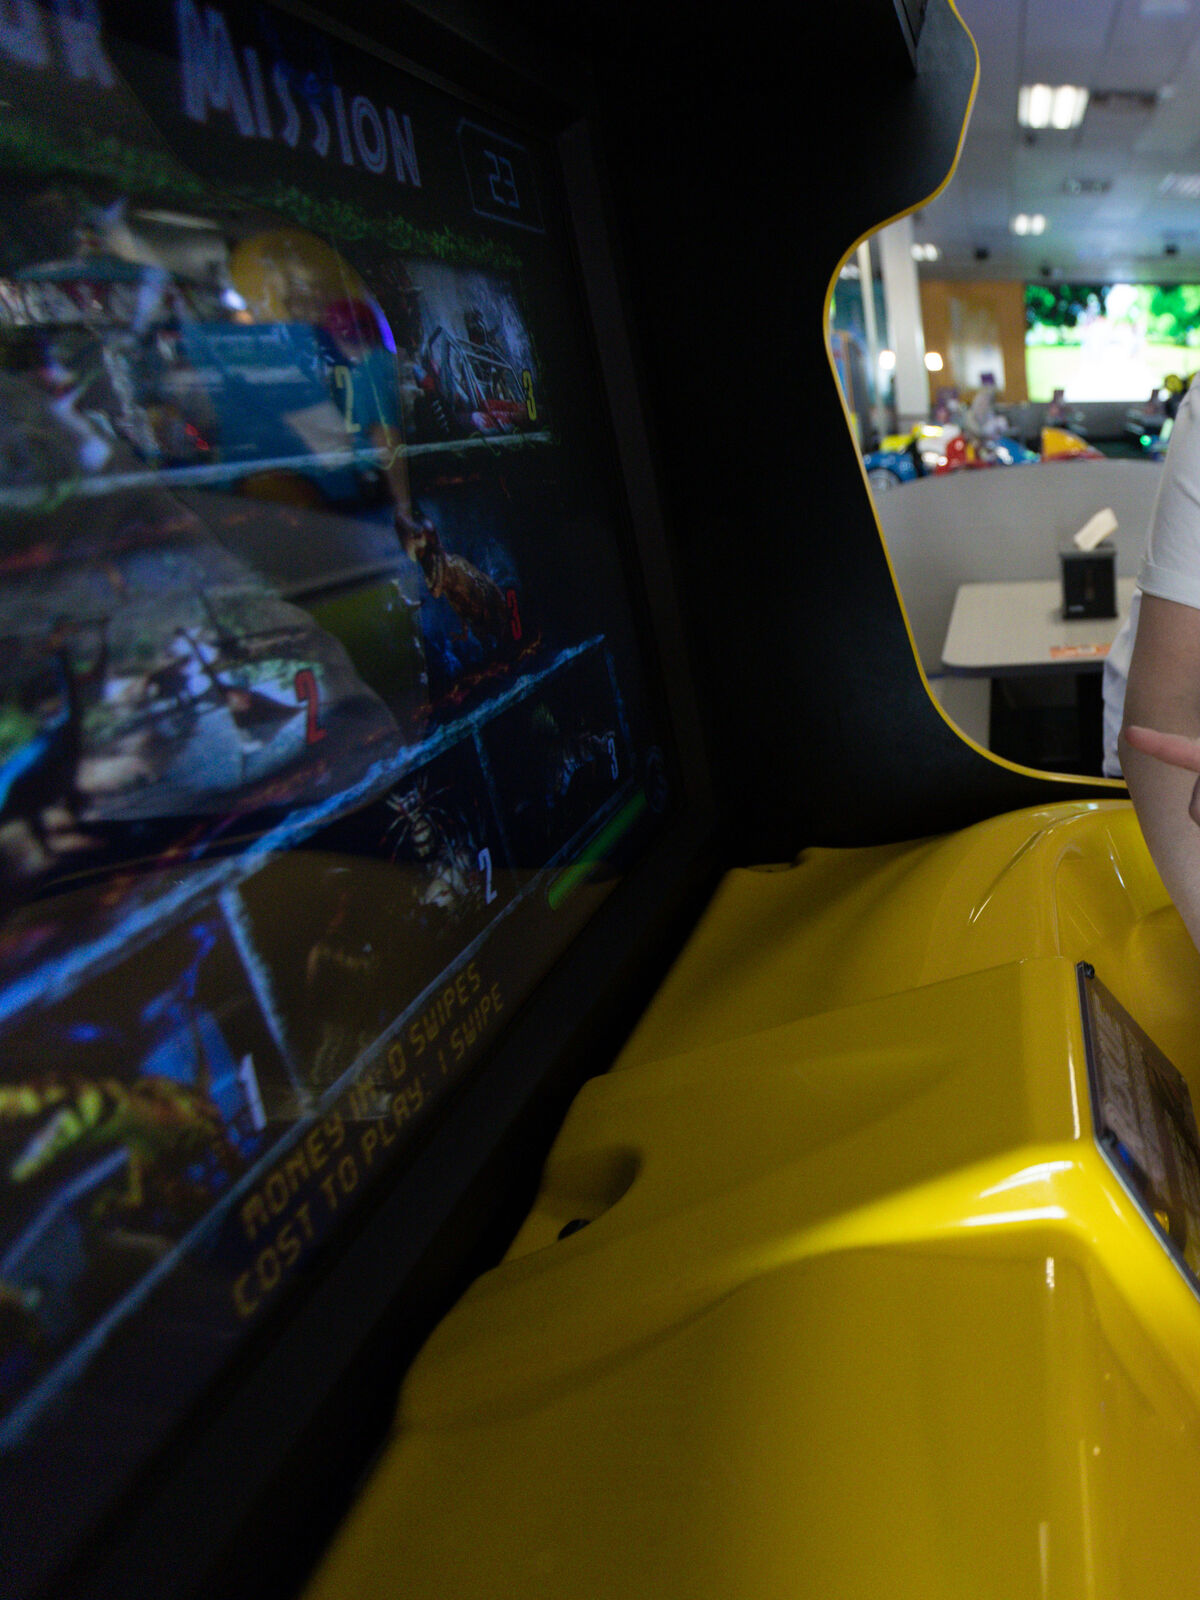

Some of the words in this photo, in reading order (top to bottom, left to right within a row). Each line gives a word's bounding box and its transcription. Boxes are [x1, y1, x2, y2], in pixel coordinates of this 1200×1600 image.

[522, 370, 537, 421] 3
[478, 847, 498, 905] 2
[233, 1202, 315, 1319] COST
[320, 1154, 359, 1211] TO
[450, 982, 505, 1062] SWIPE
[241, 1111, 345, 1241] MONEY
[408, 961, 481, 1057] SWIPES
